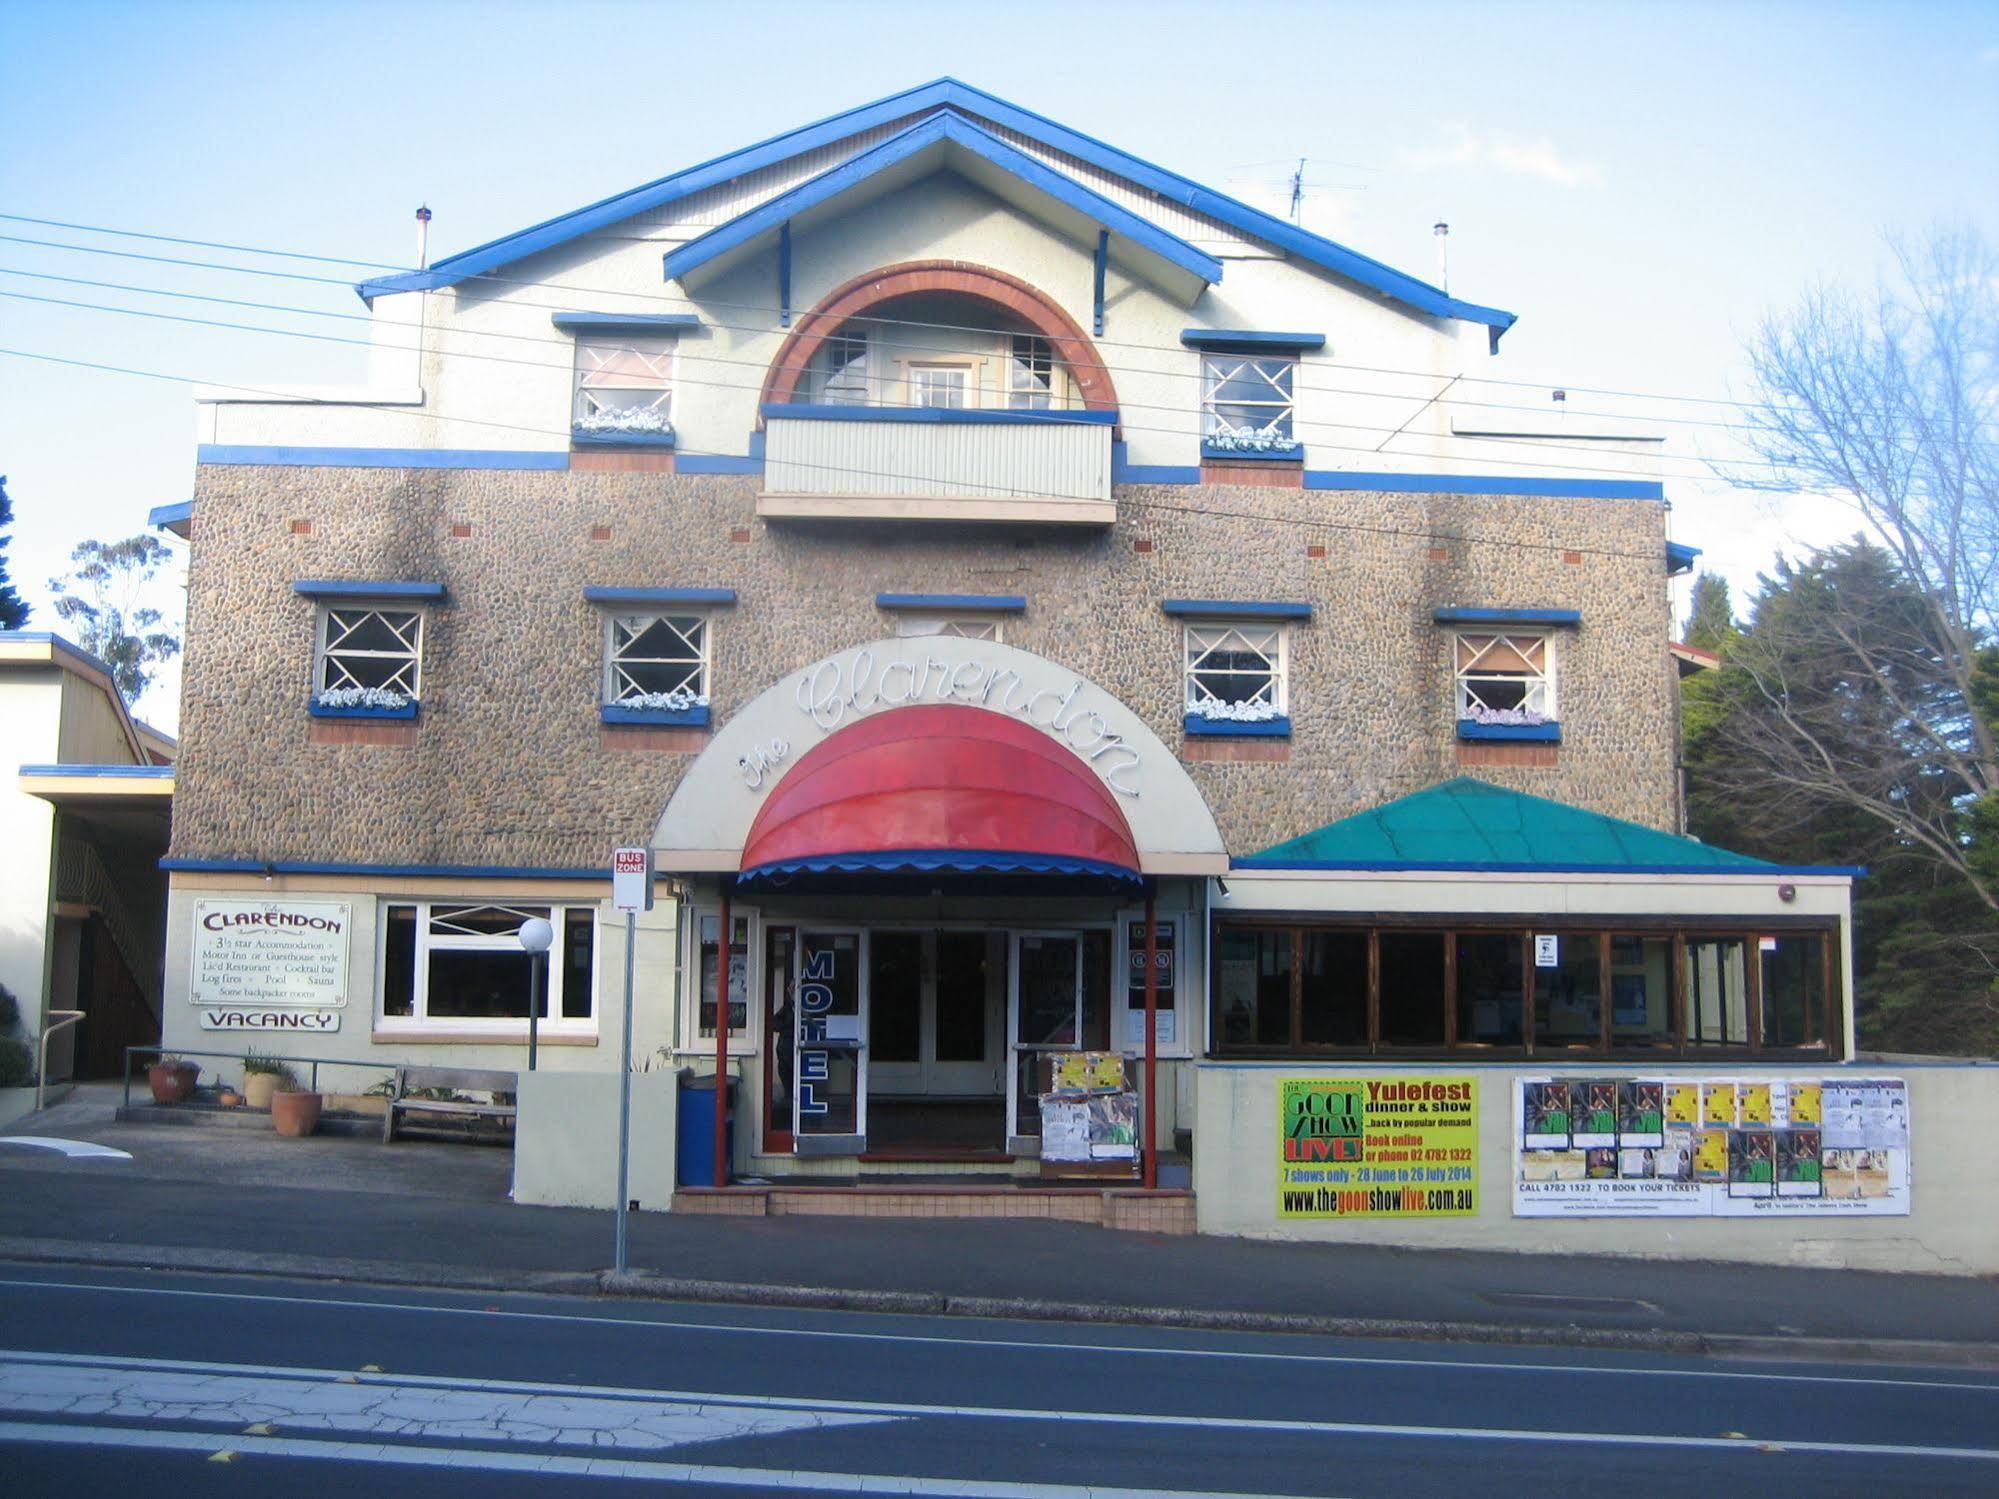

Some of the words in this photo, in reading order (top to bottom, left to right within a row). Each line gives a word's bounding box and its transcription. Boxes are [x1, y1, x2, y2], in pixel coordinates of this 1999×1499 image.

[738, 736, 791, 791] The
[797, 650, 1142, 800] Clarendon
[620, 853, 641, 862] BUS
[617, 863, 643, 872] ZONE
[203, 912, 341, 934] CLARENDON
[235, 940, 251, 949] star
[255, 940, 324, 950] Accommodation
[202, 951, 229, 960] Motor
[232, 951, 247, 960] Inn
[266, 952, 314, 962] Guesthouse
[320, 953, 338, 964] style
[226, 963, 271, 973] Restaurant
[285, 964, 319, 973] Cocktail
[322, 965, 335, 973] bar
[202, 973, 219, 985] Log
[222, 973, 242, 983] fires
[265, 975, 286, 985] Pool
[308, 976, 334, 985] Sauna
[220, 987, 242, 996] Some
[244, 987, 287, 999] backpacker
[208, 1012, 332, 1028] VACANCY
[800, 950, 835, 1114] MOTEL
[1366, 1081, 1471, 1101] Yulefest
[1365, 1101, 1415, 1112] dinner
[1418, 1102, 1428, 1112] &
[1432, 1101, 1471, 1112] show
[1393, 1119, 1403, 1129] by
[1404, 1119, 1436, 1129] popular
[1438, 1117, 1472, 1127] demand
[1366, 1135, 1390, 1146] Book
[1392, 1134, 1423, 1146] online
[1366, 1152, 1375, 1162] or
[1378, 1150, 1409, 1163] phone
[1411, 1149, 1423, 1161] 02
[1425, 1149, 1448, 1161] 4782
[1449, 1149, 1472, 1161] 1322
[1284, 1168, 1290, 1181] 7
[1292, 1168, 1325, 1182] shows
[1327, 1168, 1350, 1183] only
[1357, 1168, 1370, 1182] 28
[1372, 1168, 1396, 1182] June
[1399, 1169, 1409, 1182] to
[1426, 1167, 1445, 1183] July
[1447, 1167, 1472, 1181] 2014
[1519, 1183, 1541, 1192] CALL
[1598, 1184, 1610, 1193] TO
[1612, 1184, 1637, 1193] BOOK
[1639, 1184, 1663, 1193] YOUR
[1666, 1183, 1701, 1193] TICKETS
[1284, 1186, 1472, 1215] www.thegoonshowlive.com.au
